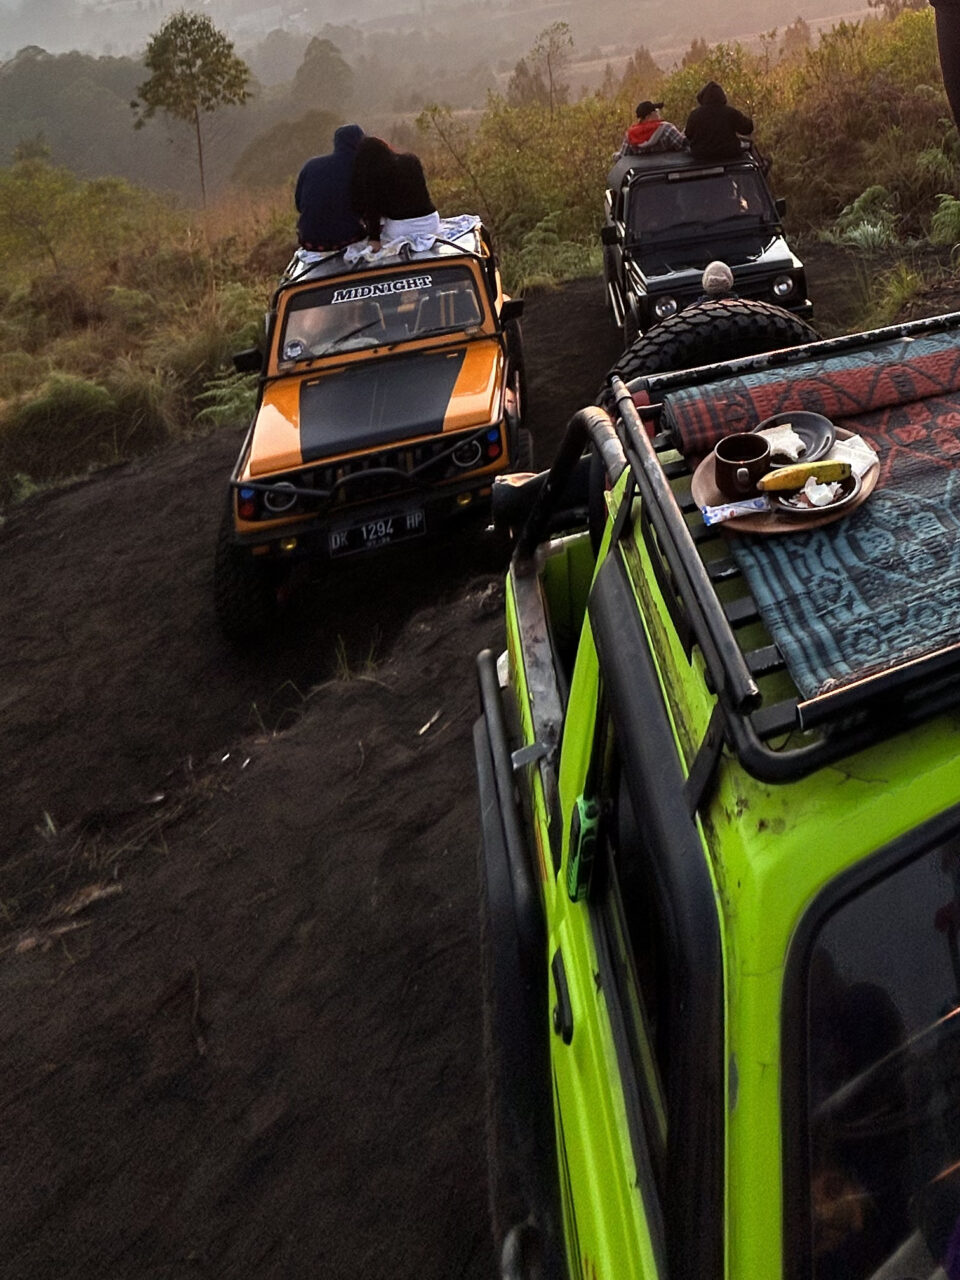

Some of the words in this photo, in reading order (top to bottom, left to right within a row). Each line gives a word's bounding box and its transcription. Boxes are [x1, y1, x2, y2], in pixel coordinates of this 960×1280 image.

[331, 275, 432, 304] MIDNIGHT
[331, 531, 348, 550] DK
[361, 518, 394, 540] 1294
[406, 512, 423, 529] HP
